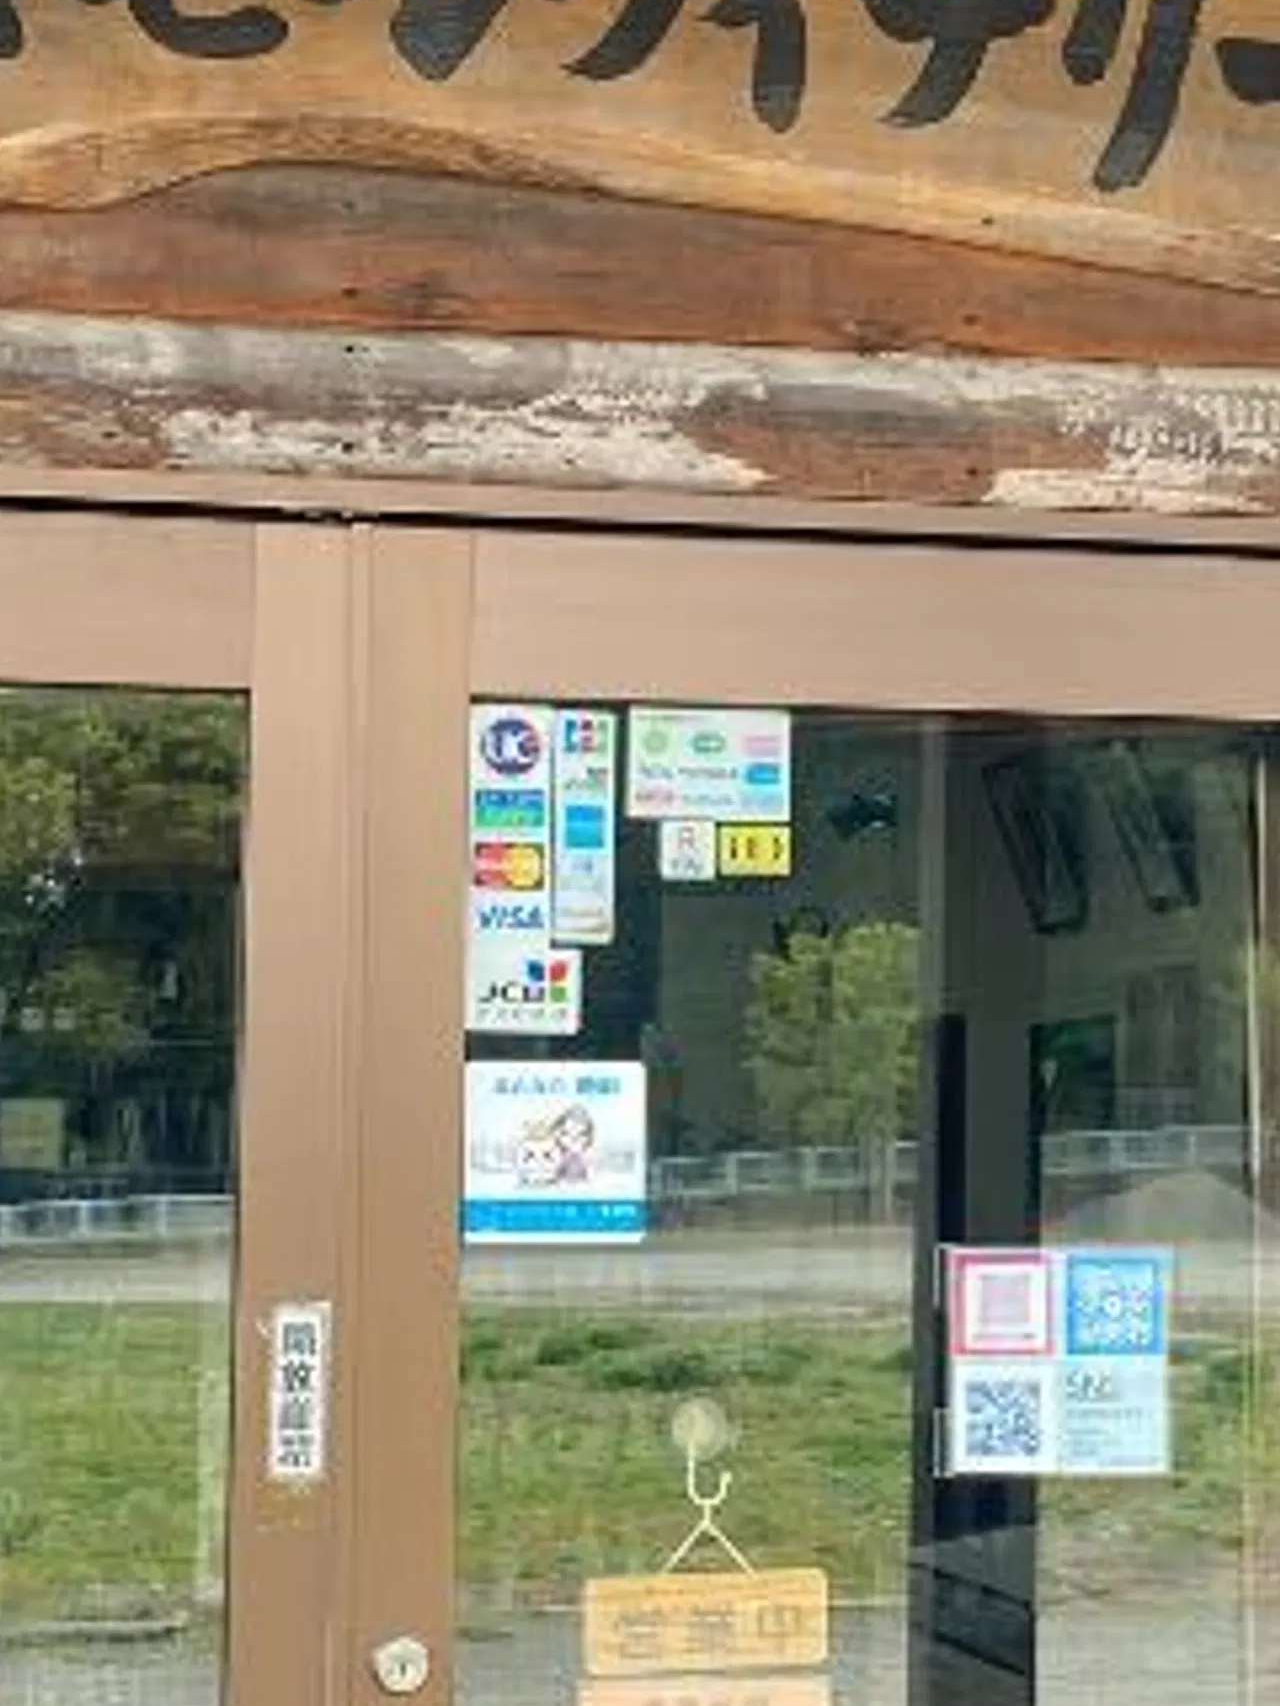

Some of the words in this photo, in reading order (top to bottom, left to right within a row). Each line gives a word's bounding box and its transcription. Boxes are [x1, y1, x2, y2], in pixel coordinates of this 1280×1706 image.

[477, 904, 546, 929] VISA
[612, 1603, 804, 1660] 営業中
